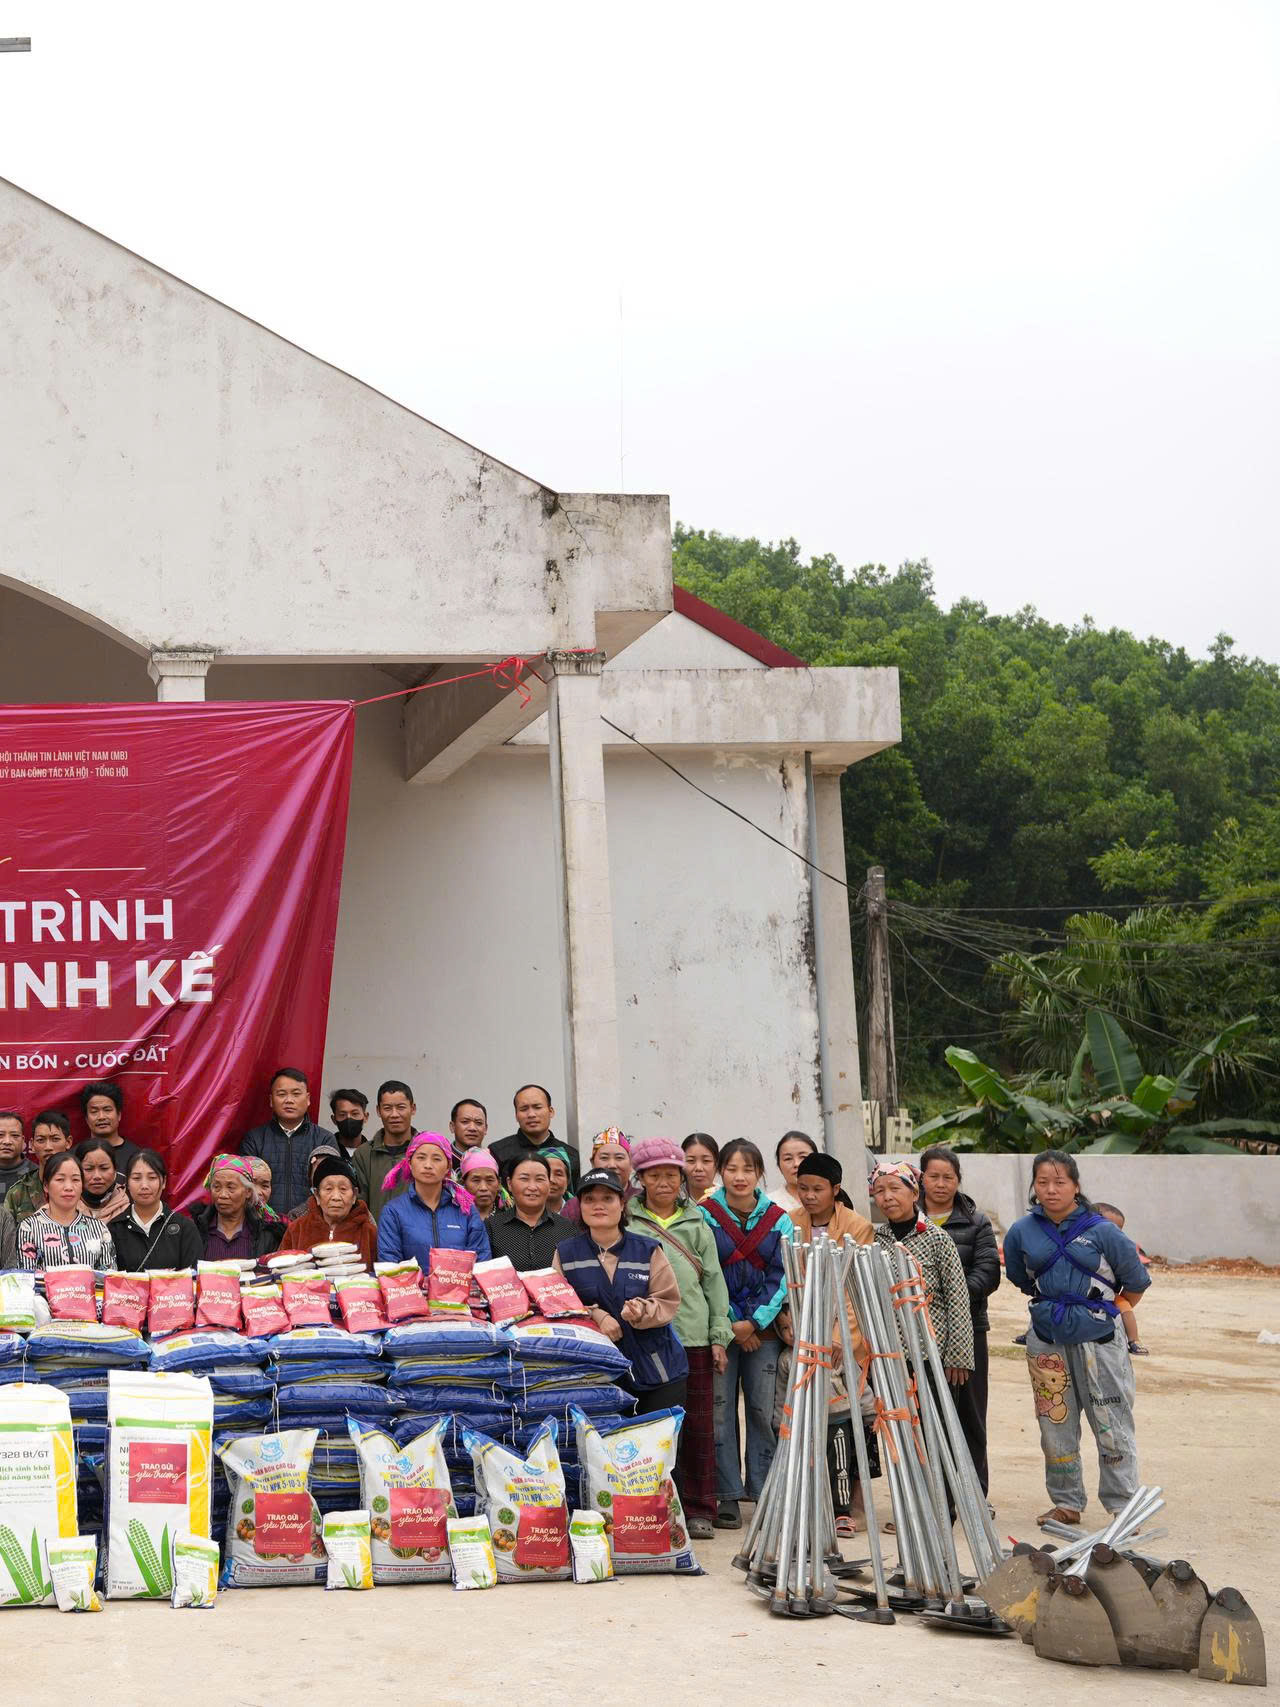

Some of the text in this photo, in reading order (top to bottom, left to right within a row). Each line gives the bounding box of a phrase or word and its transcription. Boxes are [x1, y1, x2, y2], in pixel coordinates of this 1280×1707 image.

[40, 752, 52, 761] TIN
[53, 750, 73, 761] LÀNH
[92, 751, 109, 761] NAM
[110, 751, 128, 761] (MB)
[10, 768, 26, 778] BAN
[27, 766, 47, 778] CÔNG
[48, 766, 63, 778] TÁC
[136, 944, 223, 1007] KẾ
[16, 1051, 58, 1070] BÓN
[75, 1048, 131, 1069] CUỐC
[132, 1044, 169, 1063] ĐẤT
